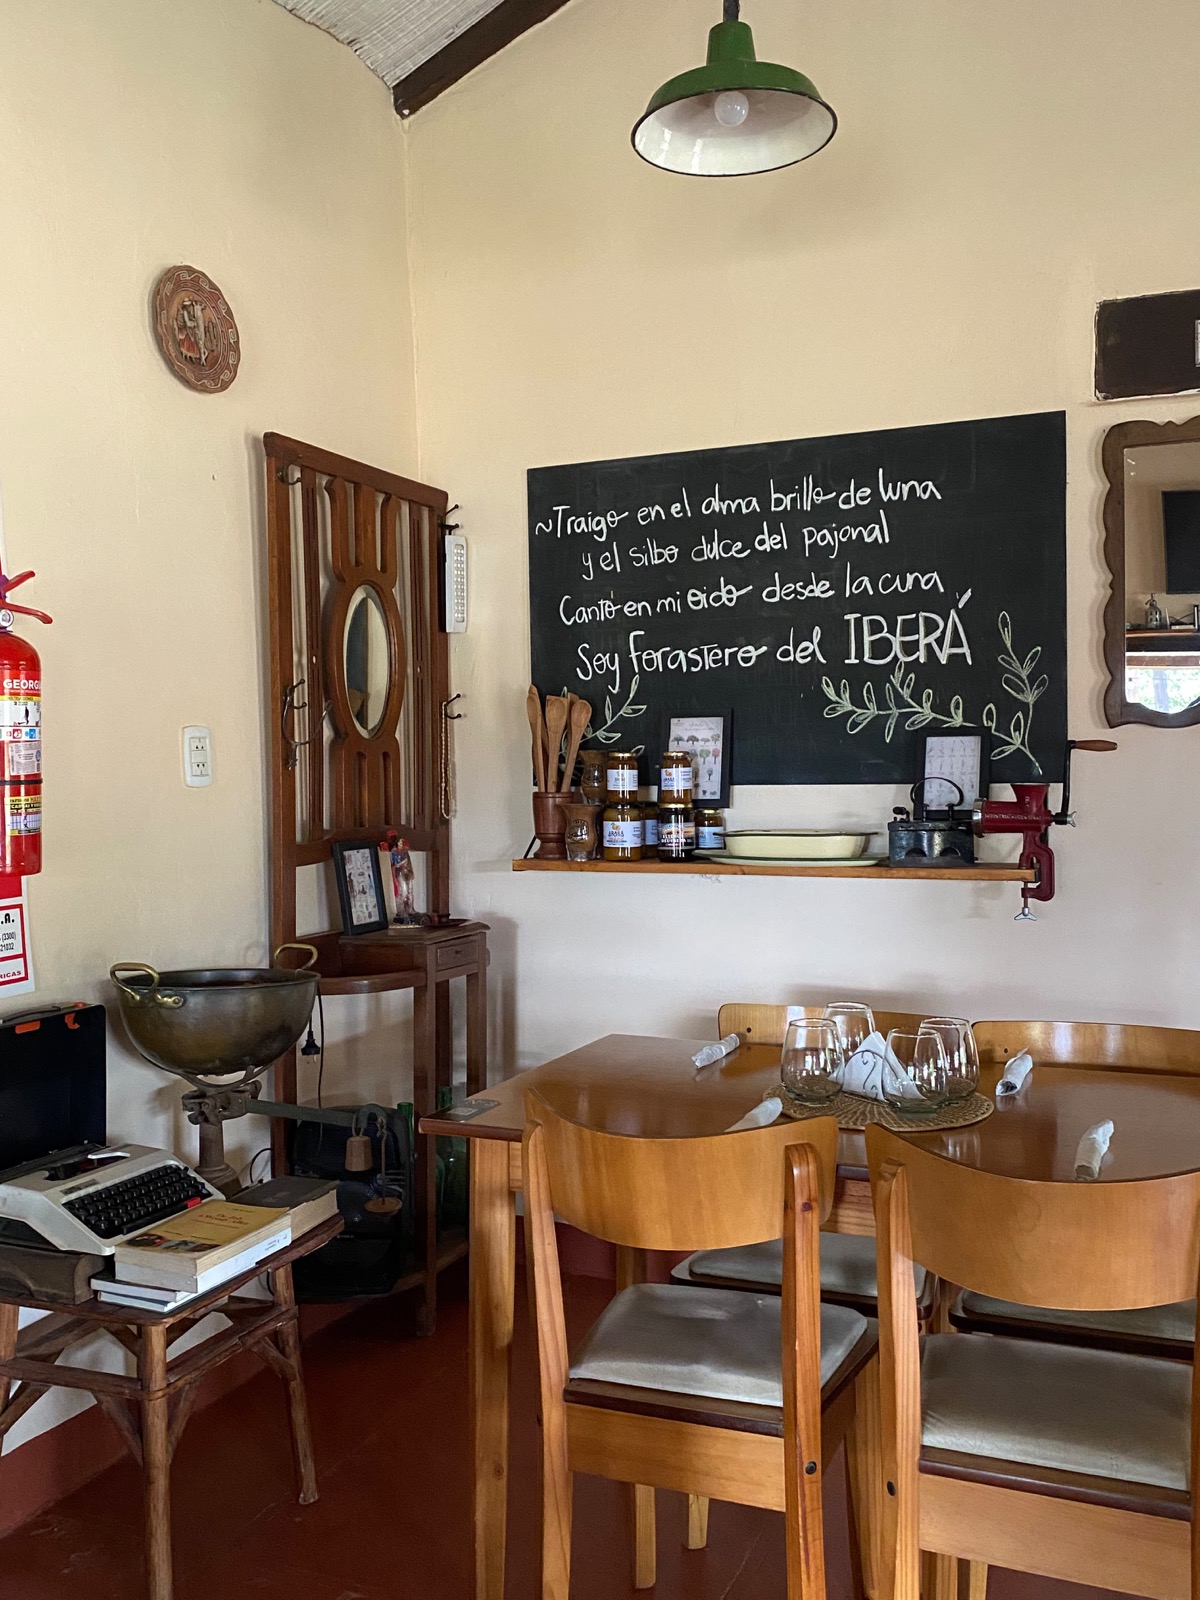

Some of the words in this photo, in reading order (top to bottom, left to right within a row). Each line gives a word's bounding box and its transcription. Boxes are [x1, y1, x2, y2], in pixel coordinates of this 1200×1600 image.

[637, 504, 666, 525] en
[670, 486, 692, 517] el
[701, 482, 760, 515] alma
[770, 474, 836, 512] brillo
[838, 478, 872, 510] de
[878, 467, 942, 502] luna
[582, 552, 594, 581] y
[600, 541, 621, 573] el
[629, 537, 679, 567] silbo
[691, 528, 751, 562] dulce
[754, 520, 788, 552] del
[802, 509, 890, 559] pajonal
[623, 600, 652, 617] en
[656, 591, 682, 613] mi
[762, 571, 835, 602] desde
[845, 561, 874, 598] la
[878, 570, 945, 595] cuna
[576, 643, 621, 694] Soy
[776, 625, 827, 664] del
[844, 588, 972, 665] IBERÁ
